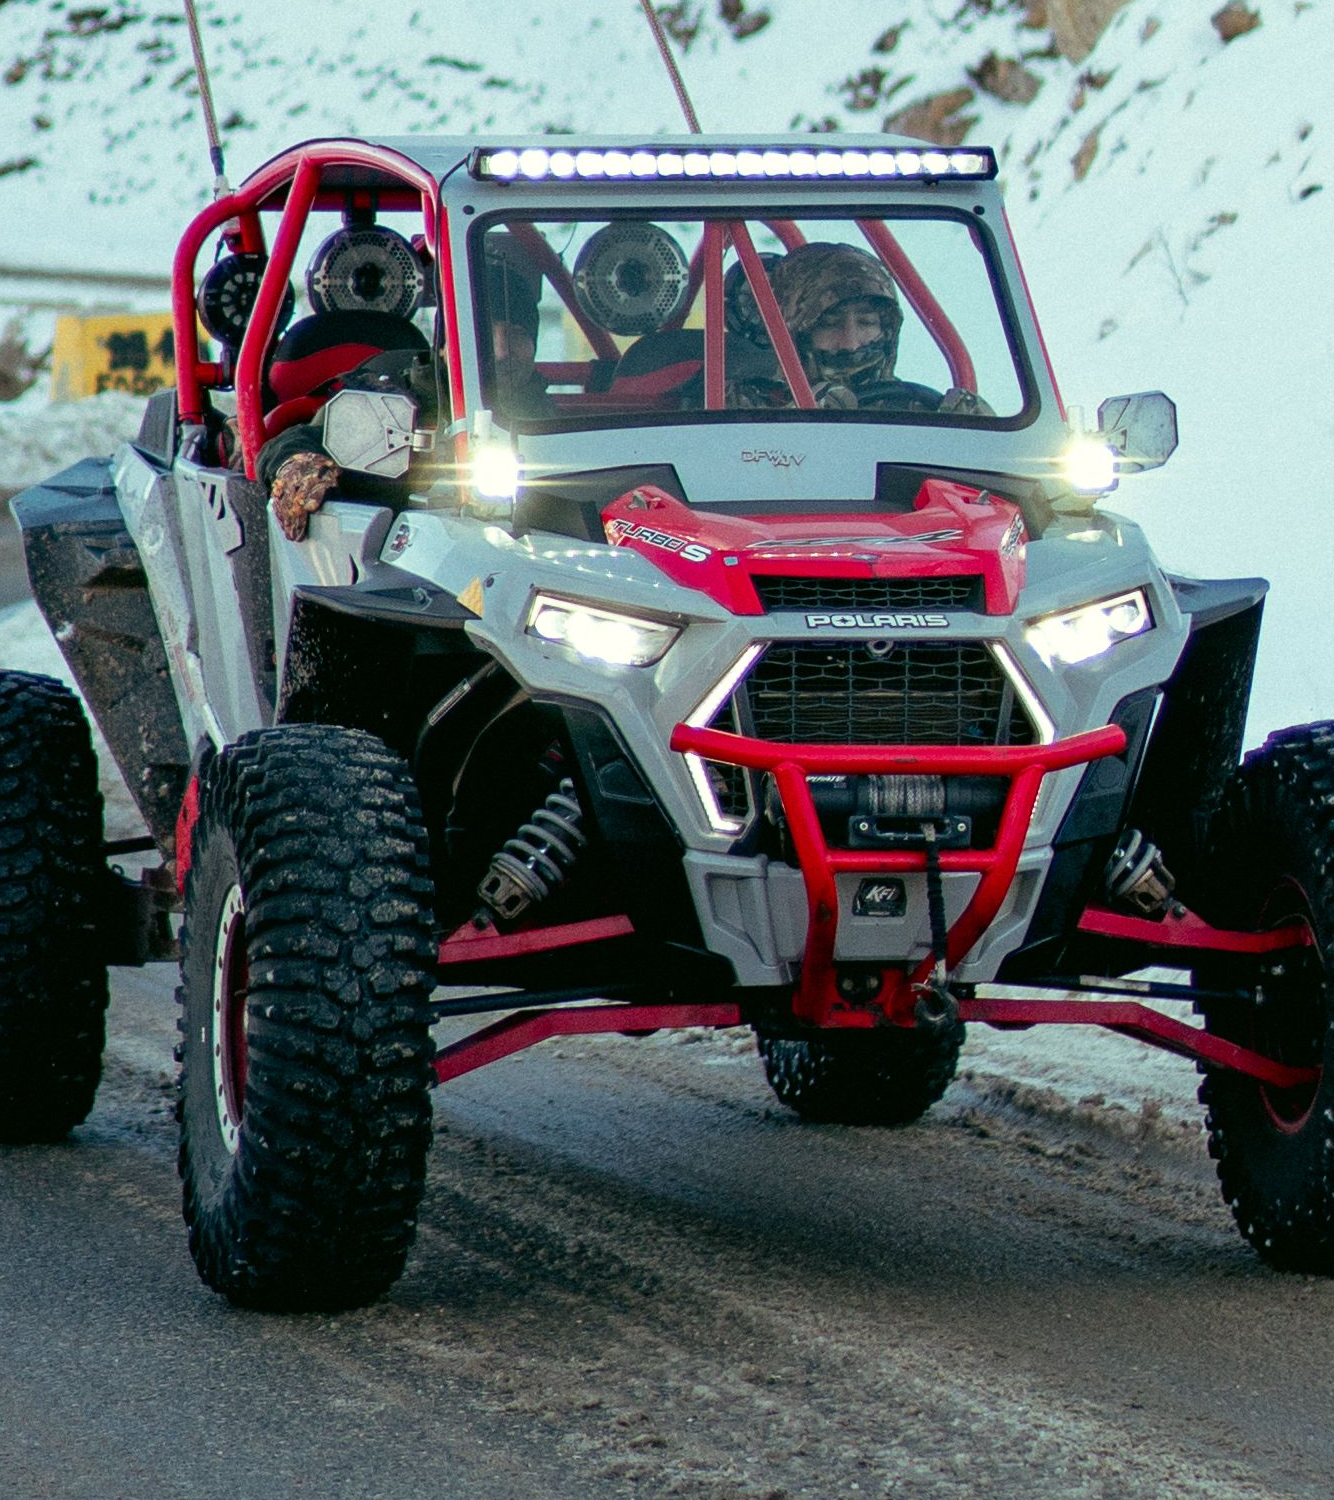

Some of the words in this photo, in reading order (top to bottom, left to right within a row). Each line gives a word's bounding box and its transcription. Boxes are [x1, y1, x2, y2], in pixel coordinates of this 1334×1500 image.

[612, 518, 687, 552] TURBO
[679, 543, 712, 562] S
[806, 614, 950, 628] POLARIS
